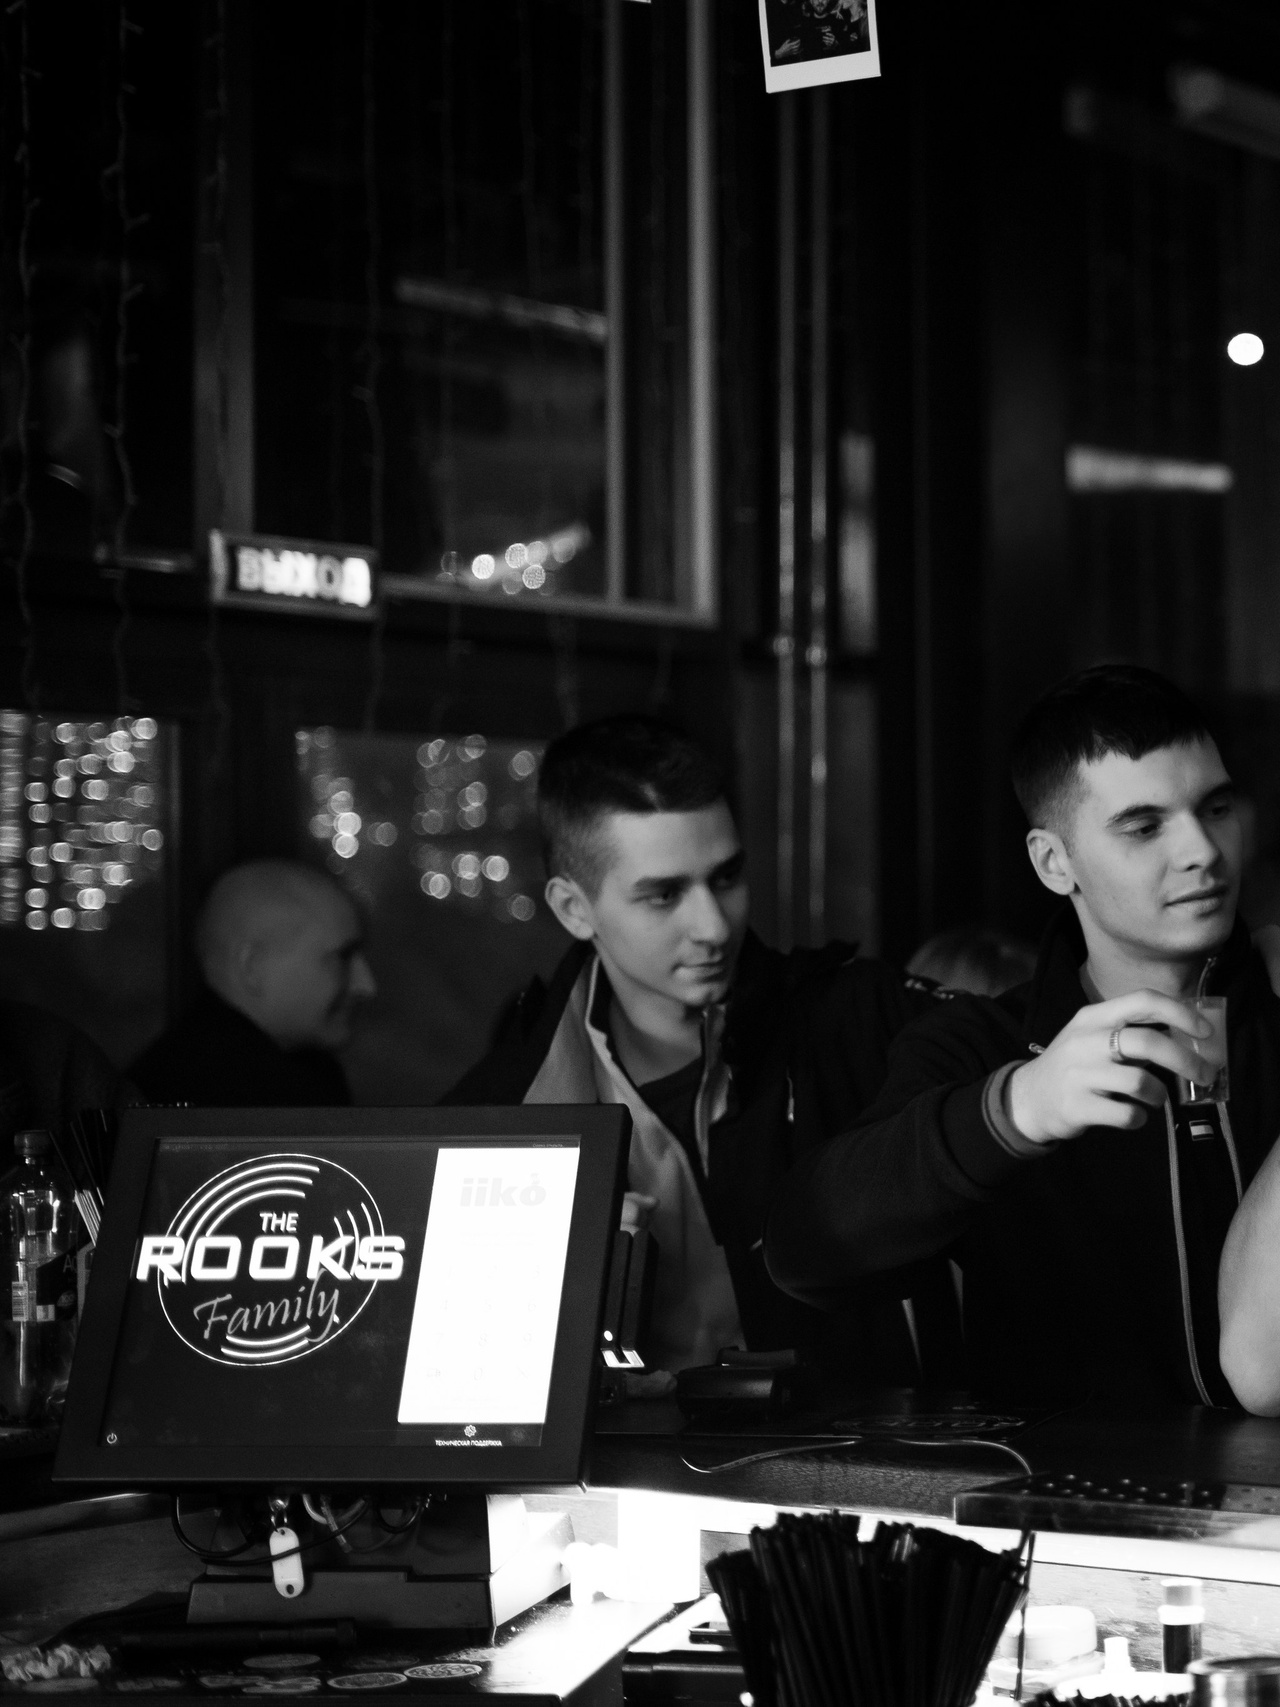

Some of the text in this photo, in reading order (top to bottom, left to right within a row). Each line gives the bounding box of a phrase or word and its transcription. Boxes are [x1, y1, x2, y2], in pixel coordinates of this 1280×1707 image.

[259, 1211, 299, 1233] THE
[136, 1234, 406, 1281] ROOKS
[193, 1267, 340, 1343] Family
